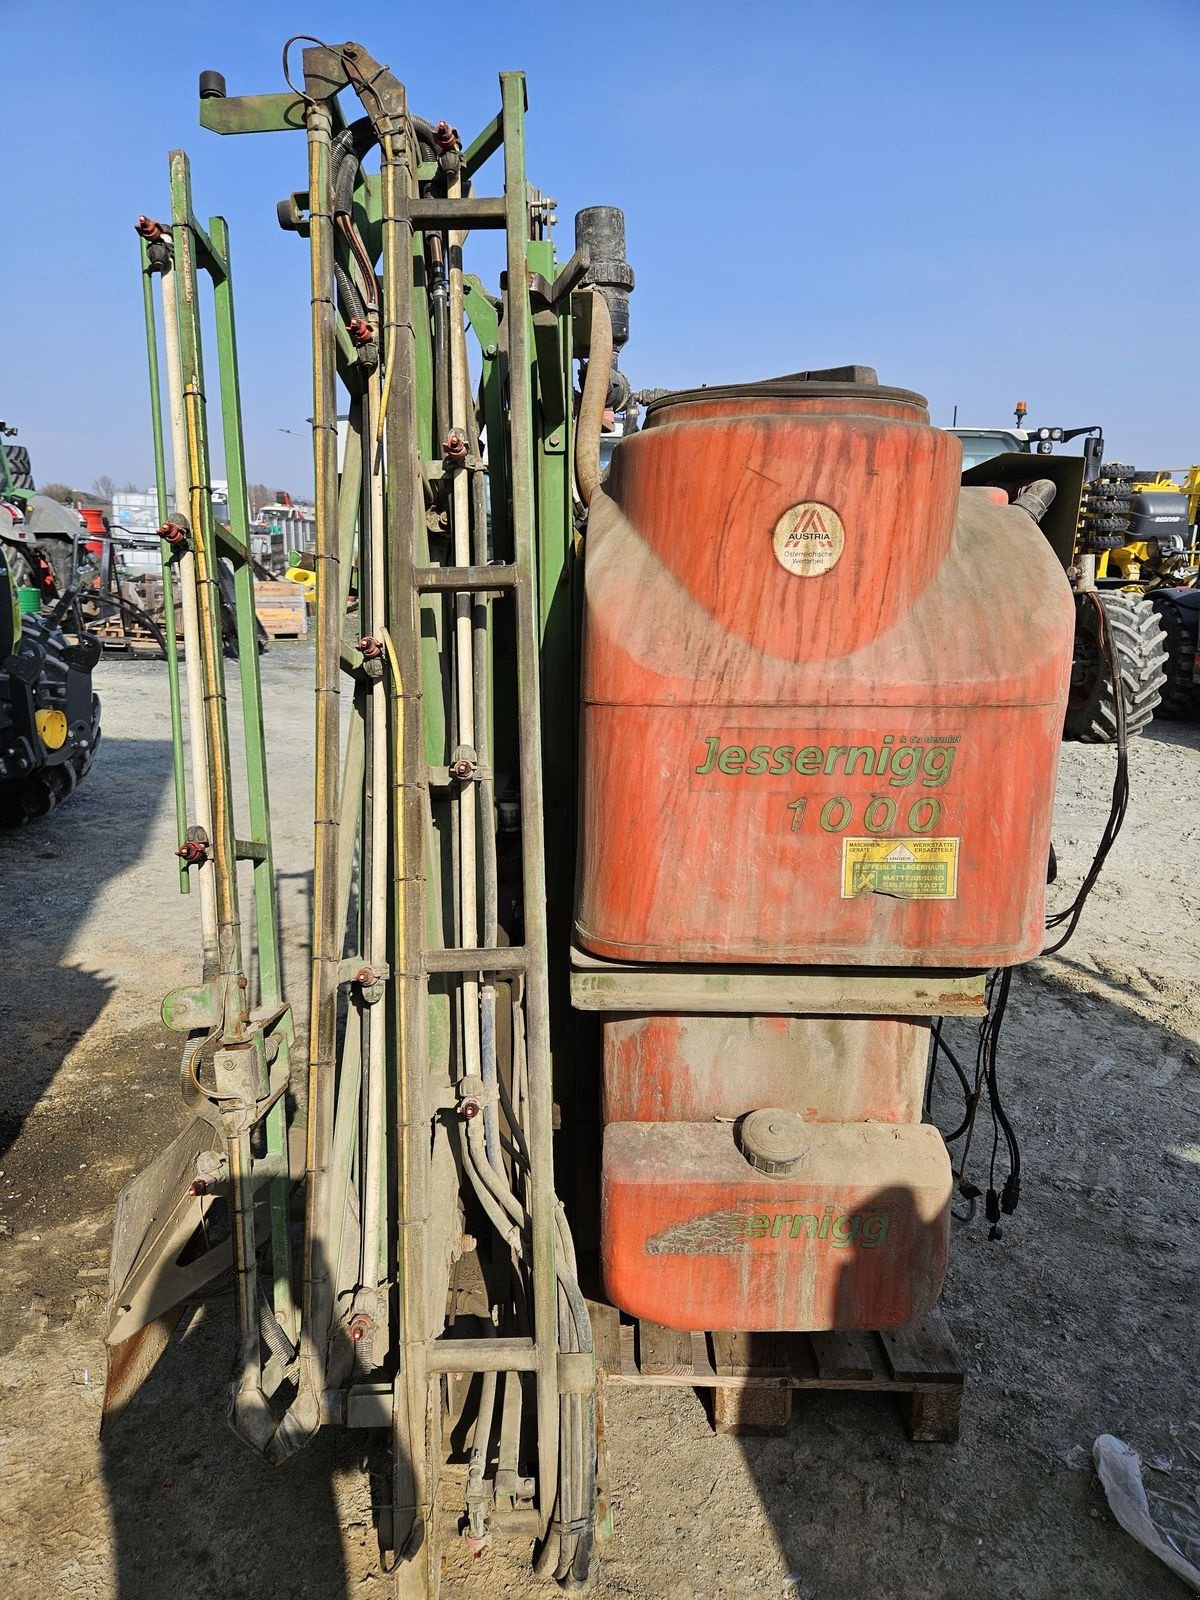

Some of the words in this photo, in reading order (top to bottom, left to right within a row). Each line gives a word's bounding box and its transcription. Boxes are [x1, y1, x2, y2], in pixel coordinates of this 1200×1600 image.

[695, 735, 957, 788] Jessernigg
[786, 796, 942, 834] 1000
[730, 1206, 892, 1249] ernigg
